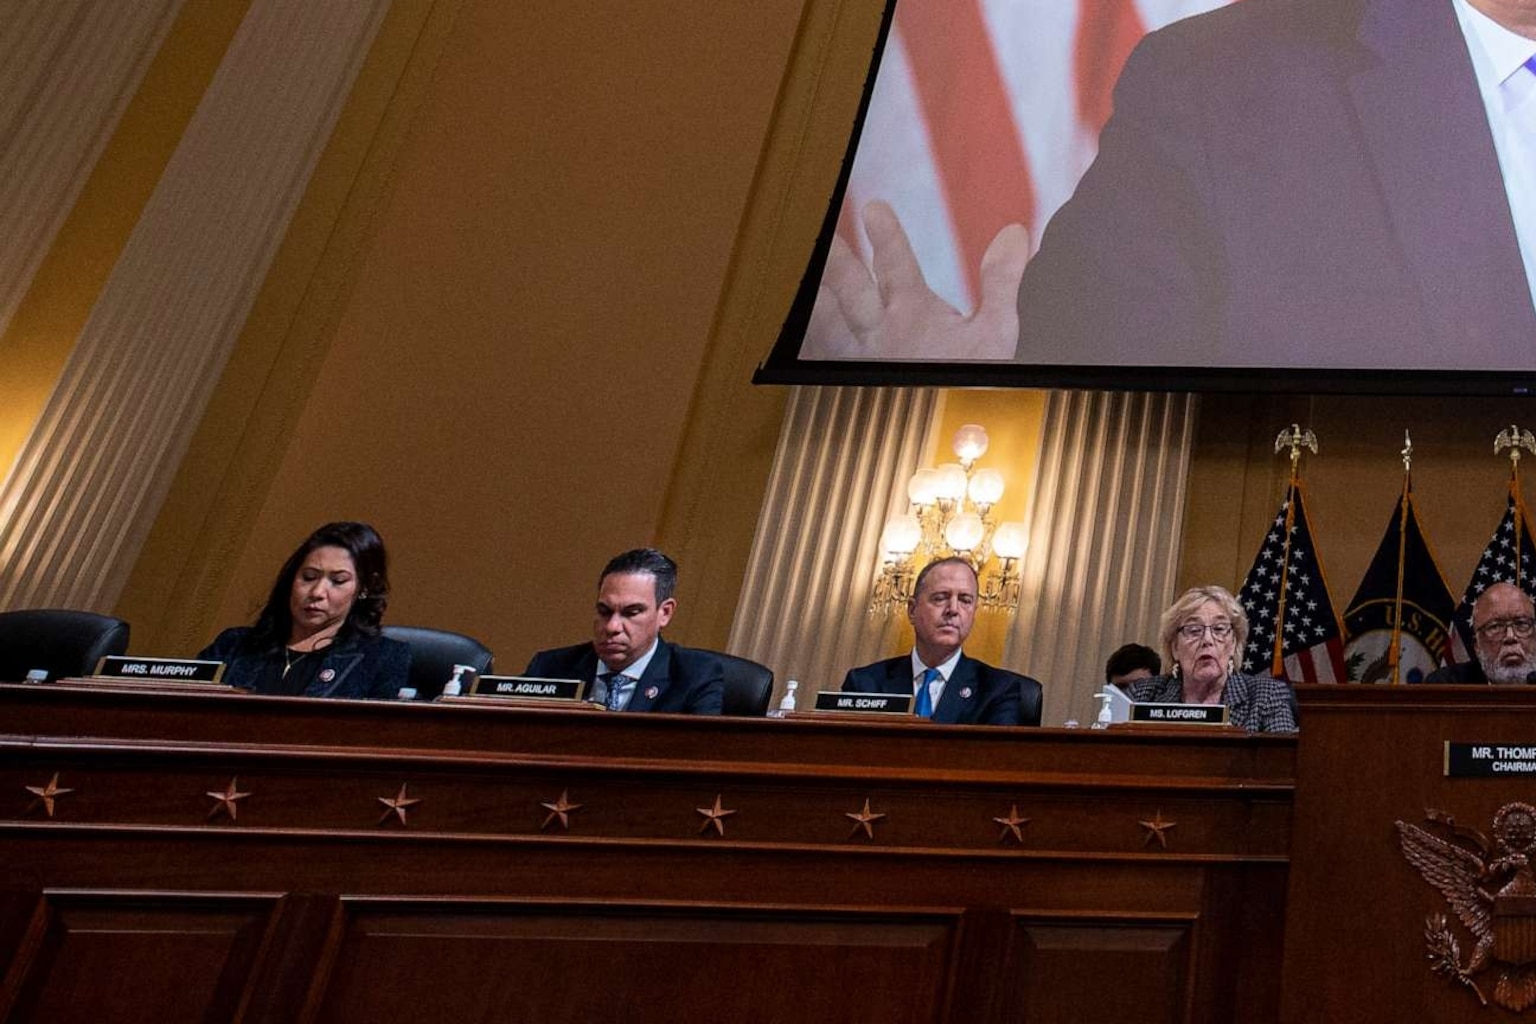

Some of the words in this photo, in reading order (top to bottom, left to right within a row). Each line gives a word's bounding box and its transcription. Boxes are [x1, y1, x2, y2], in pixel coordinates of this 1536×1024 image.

[121, 663, 148, 674] MRS.
[149, 664, 198, 676] MURPHY
[496, 682, 514, 692] MR.
[514, 683, 557, 694] AGUILAR
[837, 698, 854, 708] MR.
[854, 698, 888, 709] SCHIFF
[1149, 708, 1166, 718] MS.
[1166, 709, 1207, 719] LOFGREN
[1472, 746, 1494, 759] MR.
